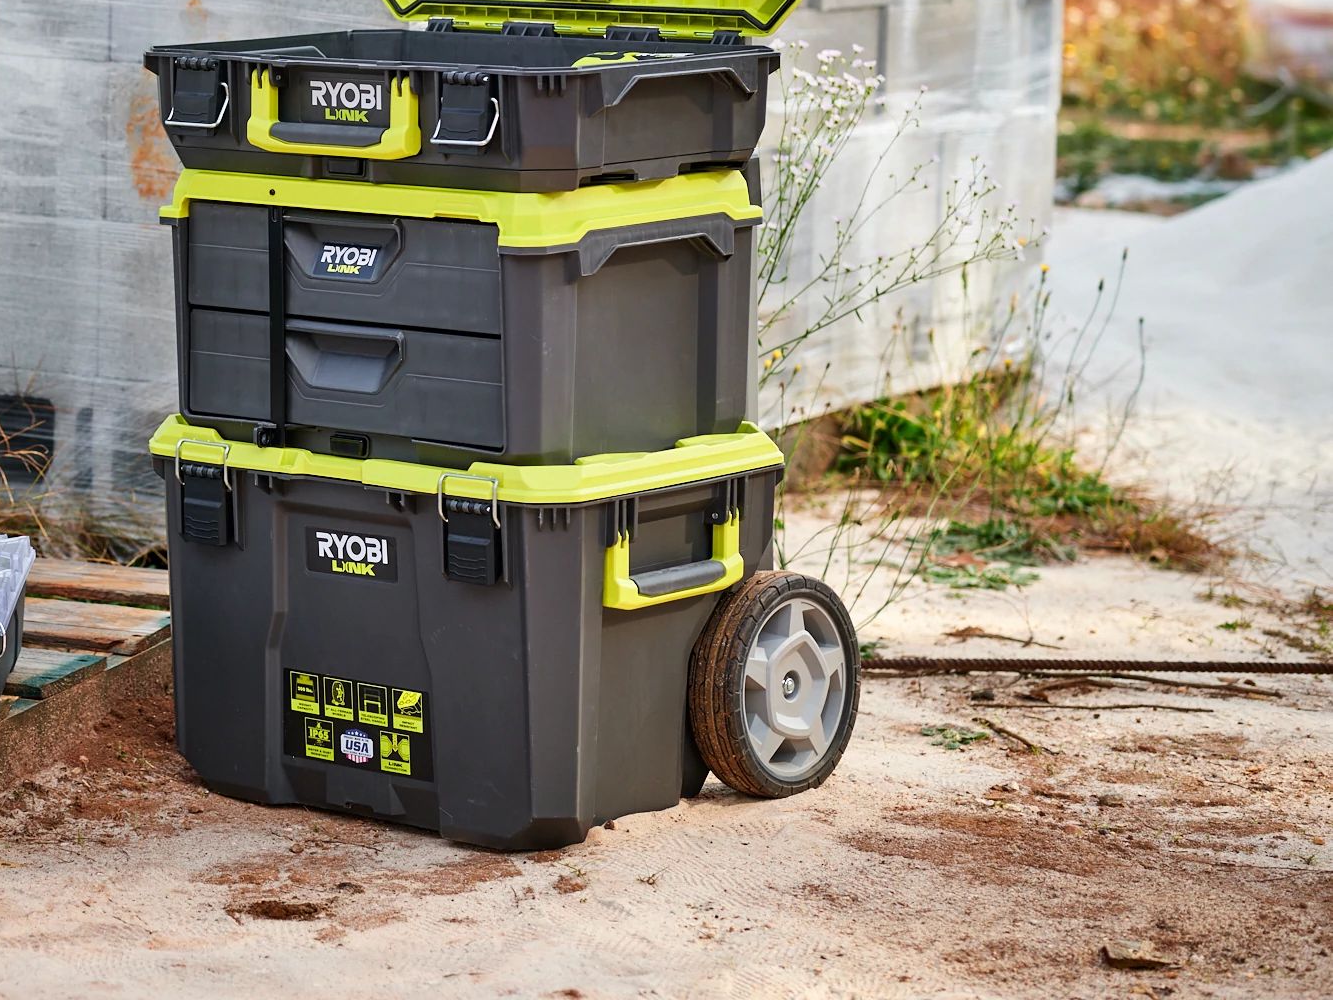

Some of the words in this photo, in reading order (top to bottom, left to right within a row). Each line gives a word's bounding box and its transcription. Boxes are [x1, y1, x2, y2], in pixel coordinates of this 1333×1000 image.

[309, 80, 382, 110] RYOBI
[320, 245, 378, 267] RYOBI
[315, 531, 389, 565] RYOBI
[309, 727, 329, 740] IP65
[346, 739, 369, 753] USA
